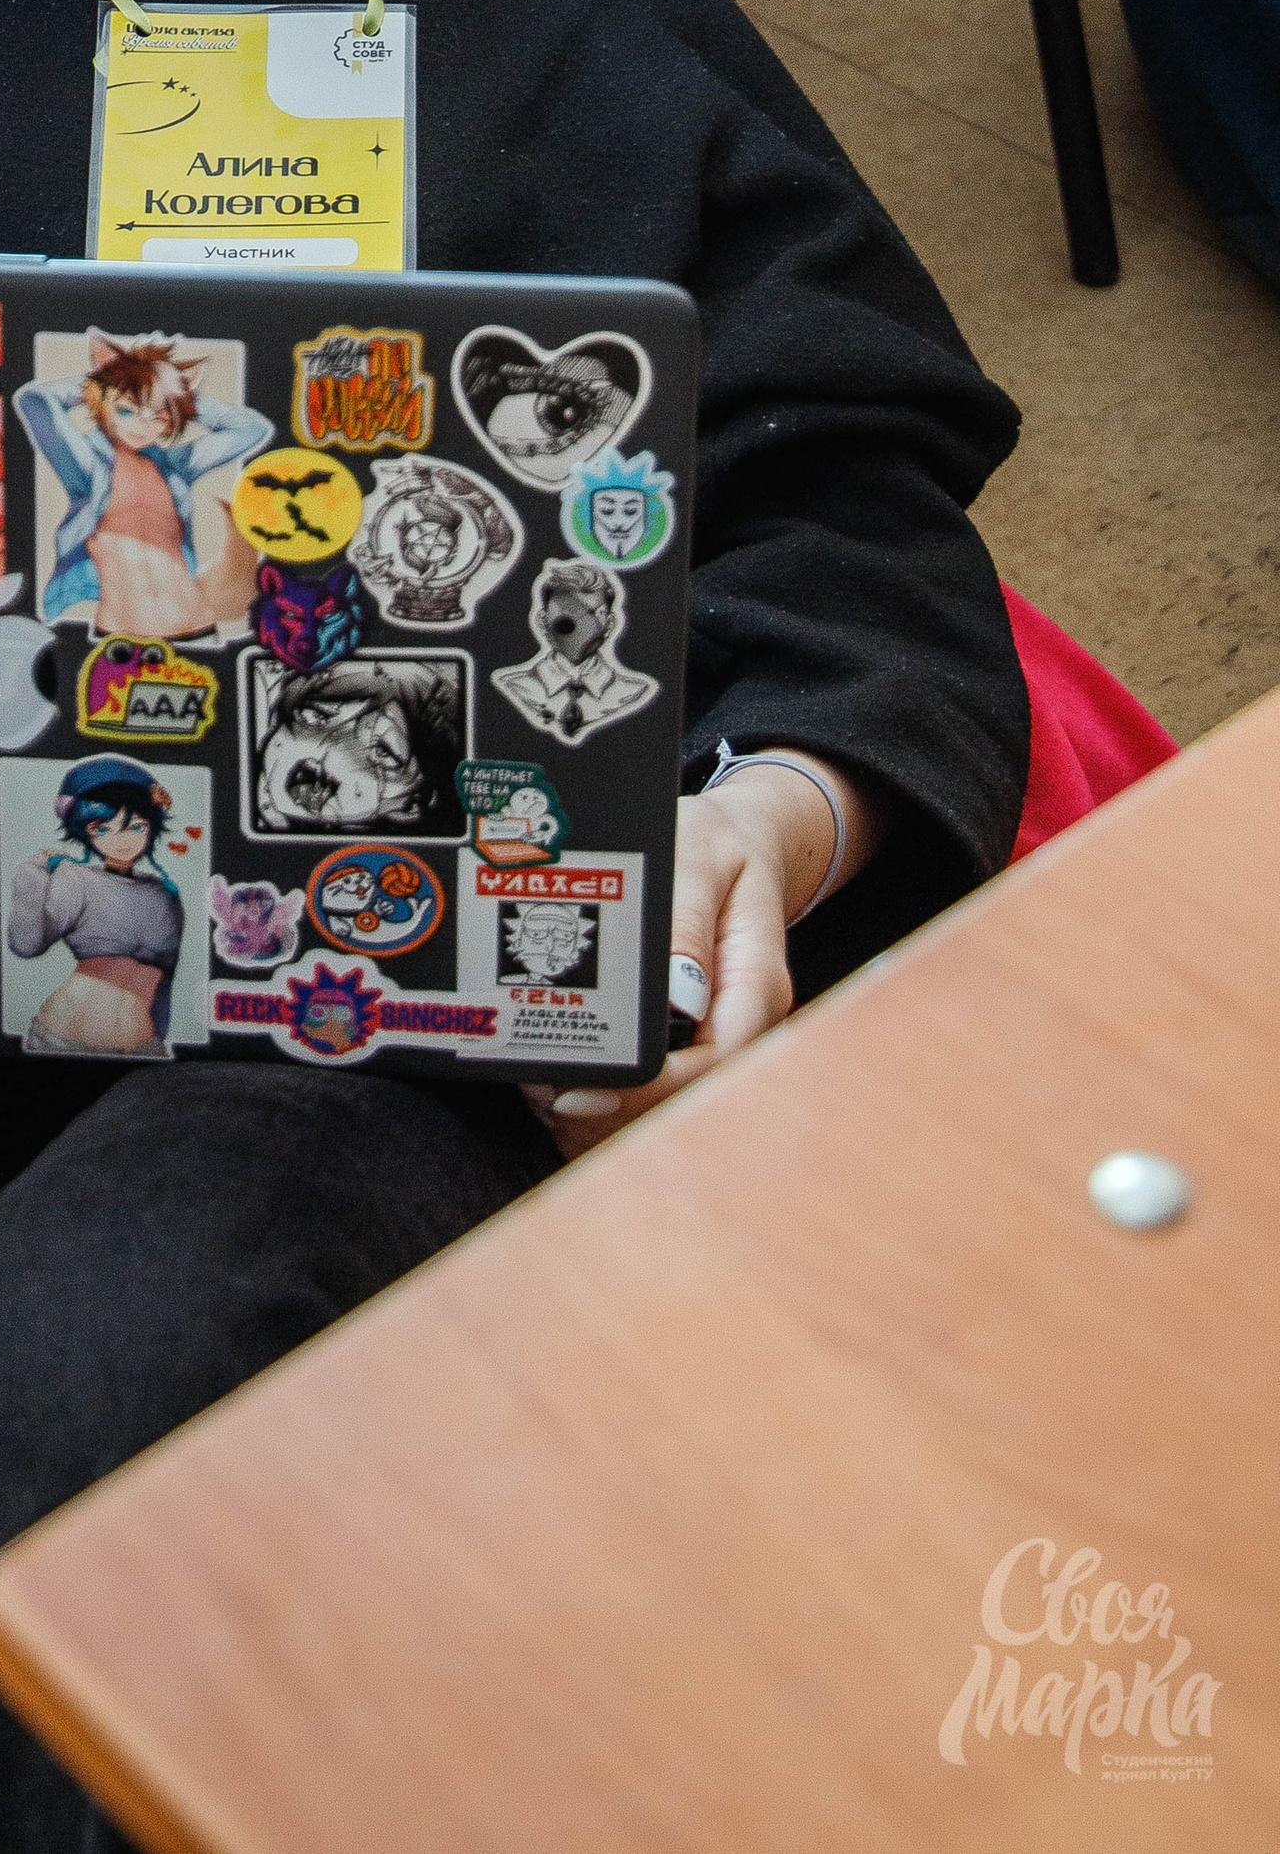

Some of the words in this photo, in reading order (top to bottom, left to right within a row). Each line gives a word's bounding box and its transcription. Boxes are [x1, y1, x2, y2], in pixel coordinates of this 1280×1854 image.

[180, 27, 236, 37] актива
[352, 40, 385, 50] СТУД
[352, 49, 394, 58] СОВЕТ
[186, 152, 319, 178] Алина
[144, 189, 360, 216] Колегова
[204, 245, 296, 260] Участник
[215, 991, 287, 1024] RICK
